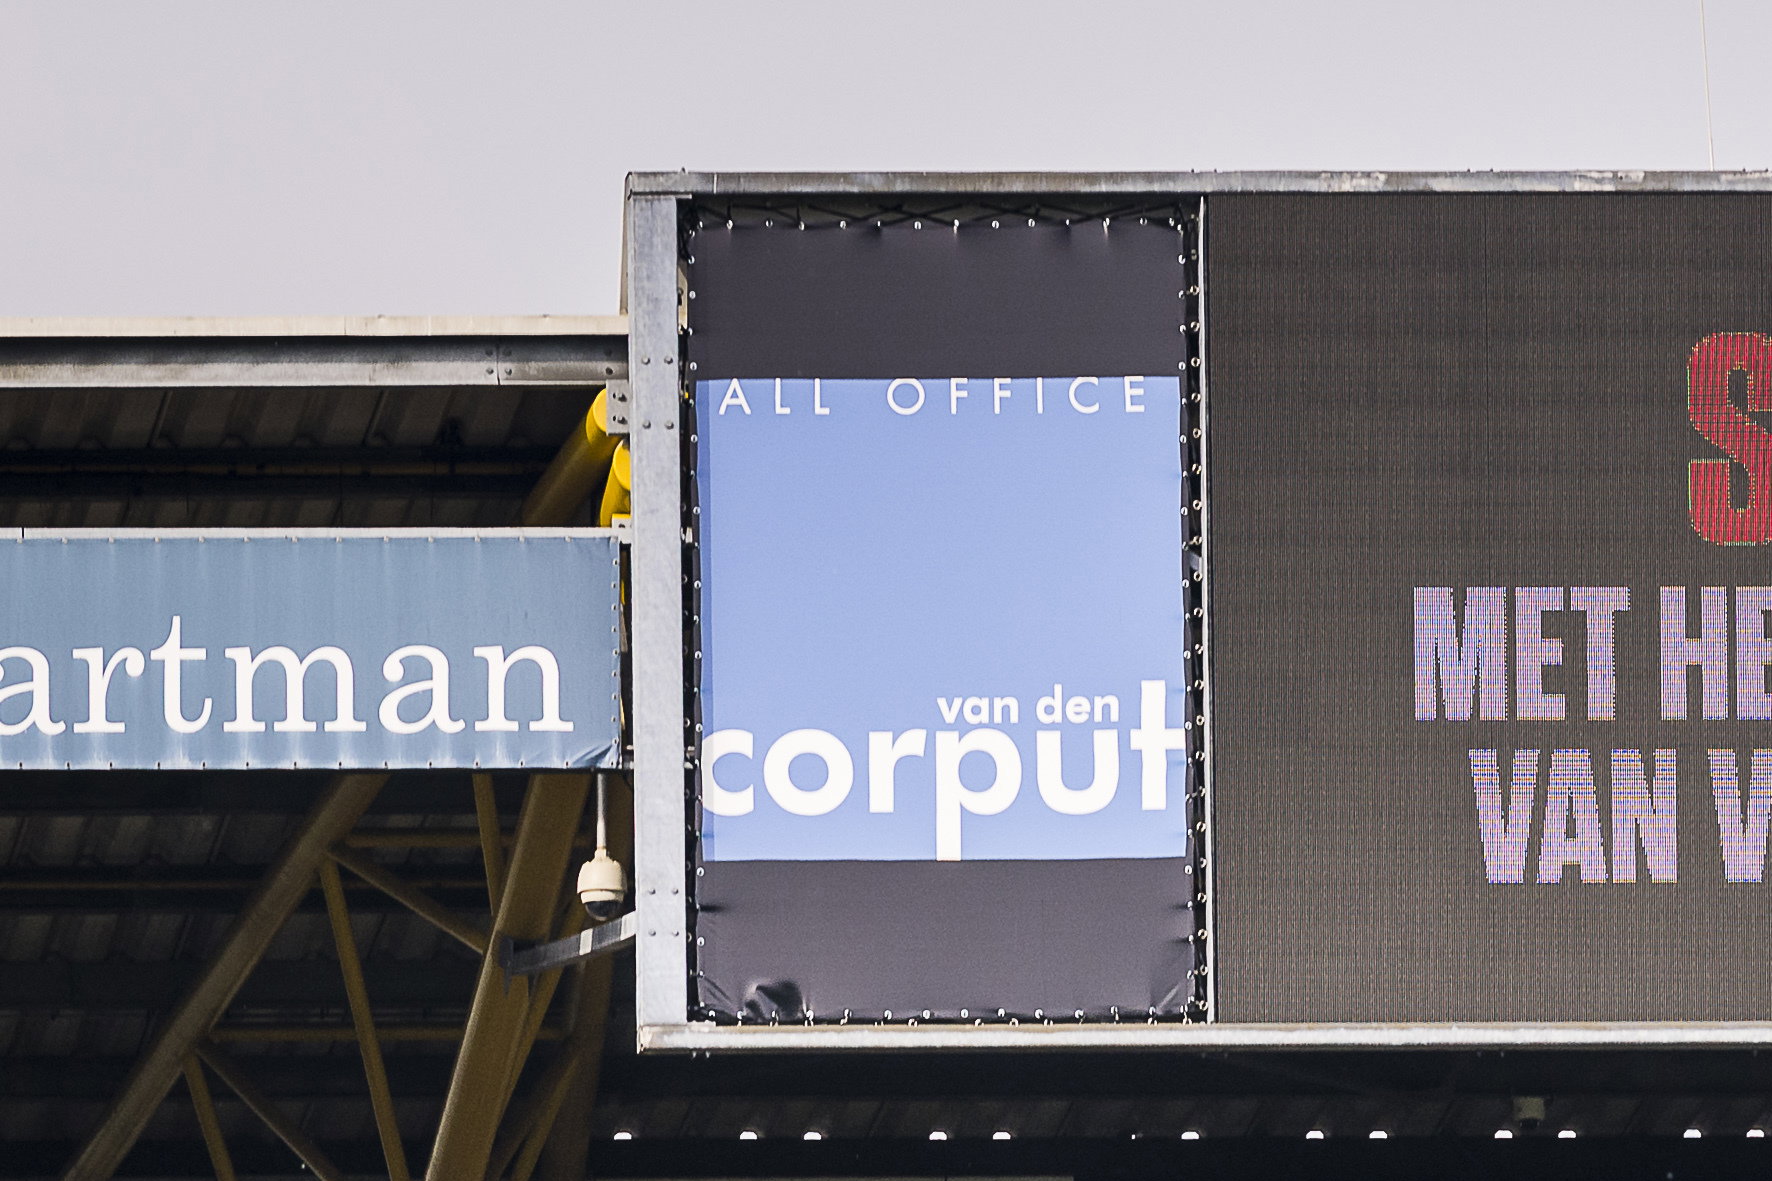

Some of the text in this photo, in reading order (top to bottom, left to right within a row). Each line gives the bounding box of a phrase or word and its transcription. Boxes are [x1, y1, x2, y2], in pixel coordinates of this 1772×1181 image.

[718, 376, 1147, 416] ALL OFFICE
[0, 616, 575, 735] artman
[937, 685, 1120, 725] van den
[1412, 586, 1631, 721] MET
[702, 680, 1186, 861] corput
[1468, 748, 1678, 883] VAN
